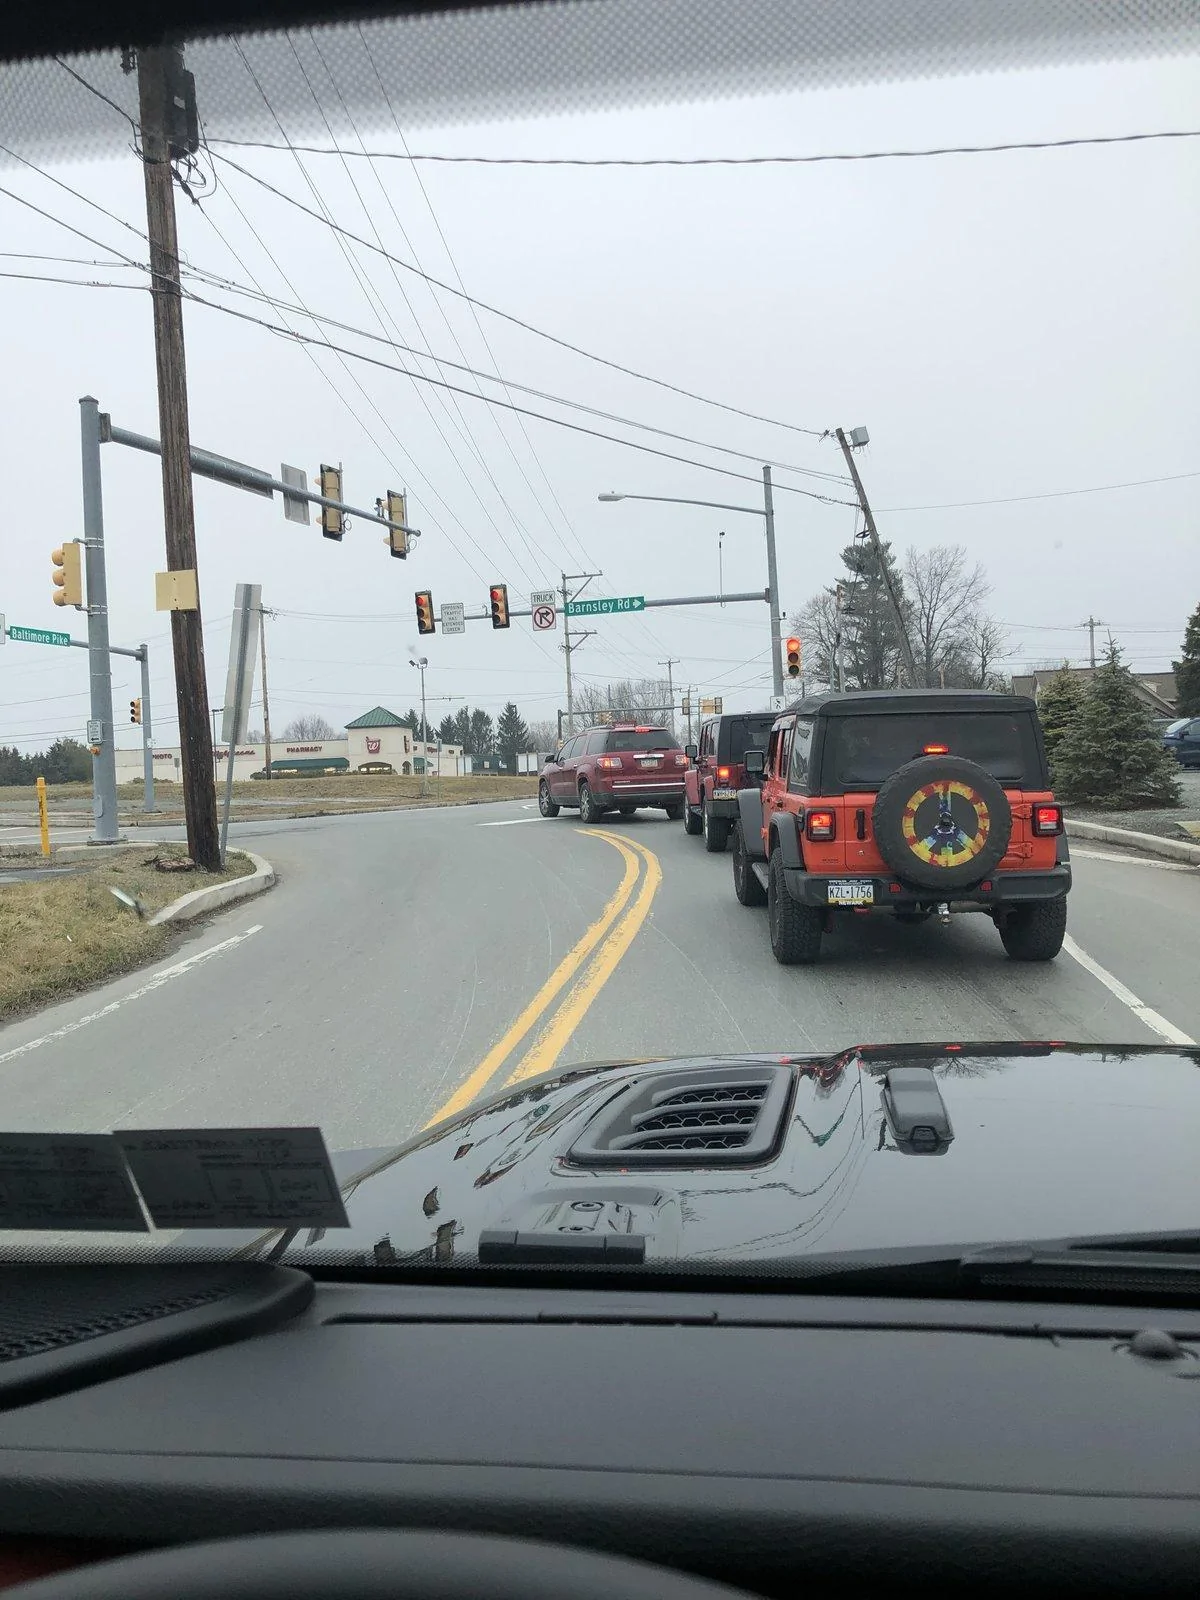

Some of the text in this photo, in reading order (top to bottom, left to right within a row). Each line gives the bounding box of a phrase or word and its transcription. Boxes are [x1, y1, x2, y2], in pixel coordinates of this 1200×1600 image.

[533, 593, 554, 603] TRUCK
[568, 598, 630, 613] Barnsley Rd
[12, 628, 68, 646] Baltimore Pike
